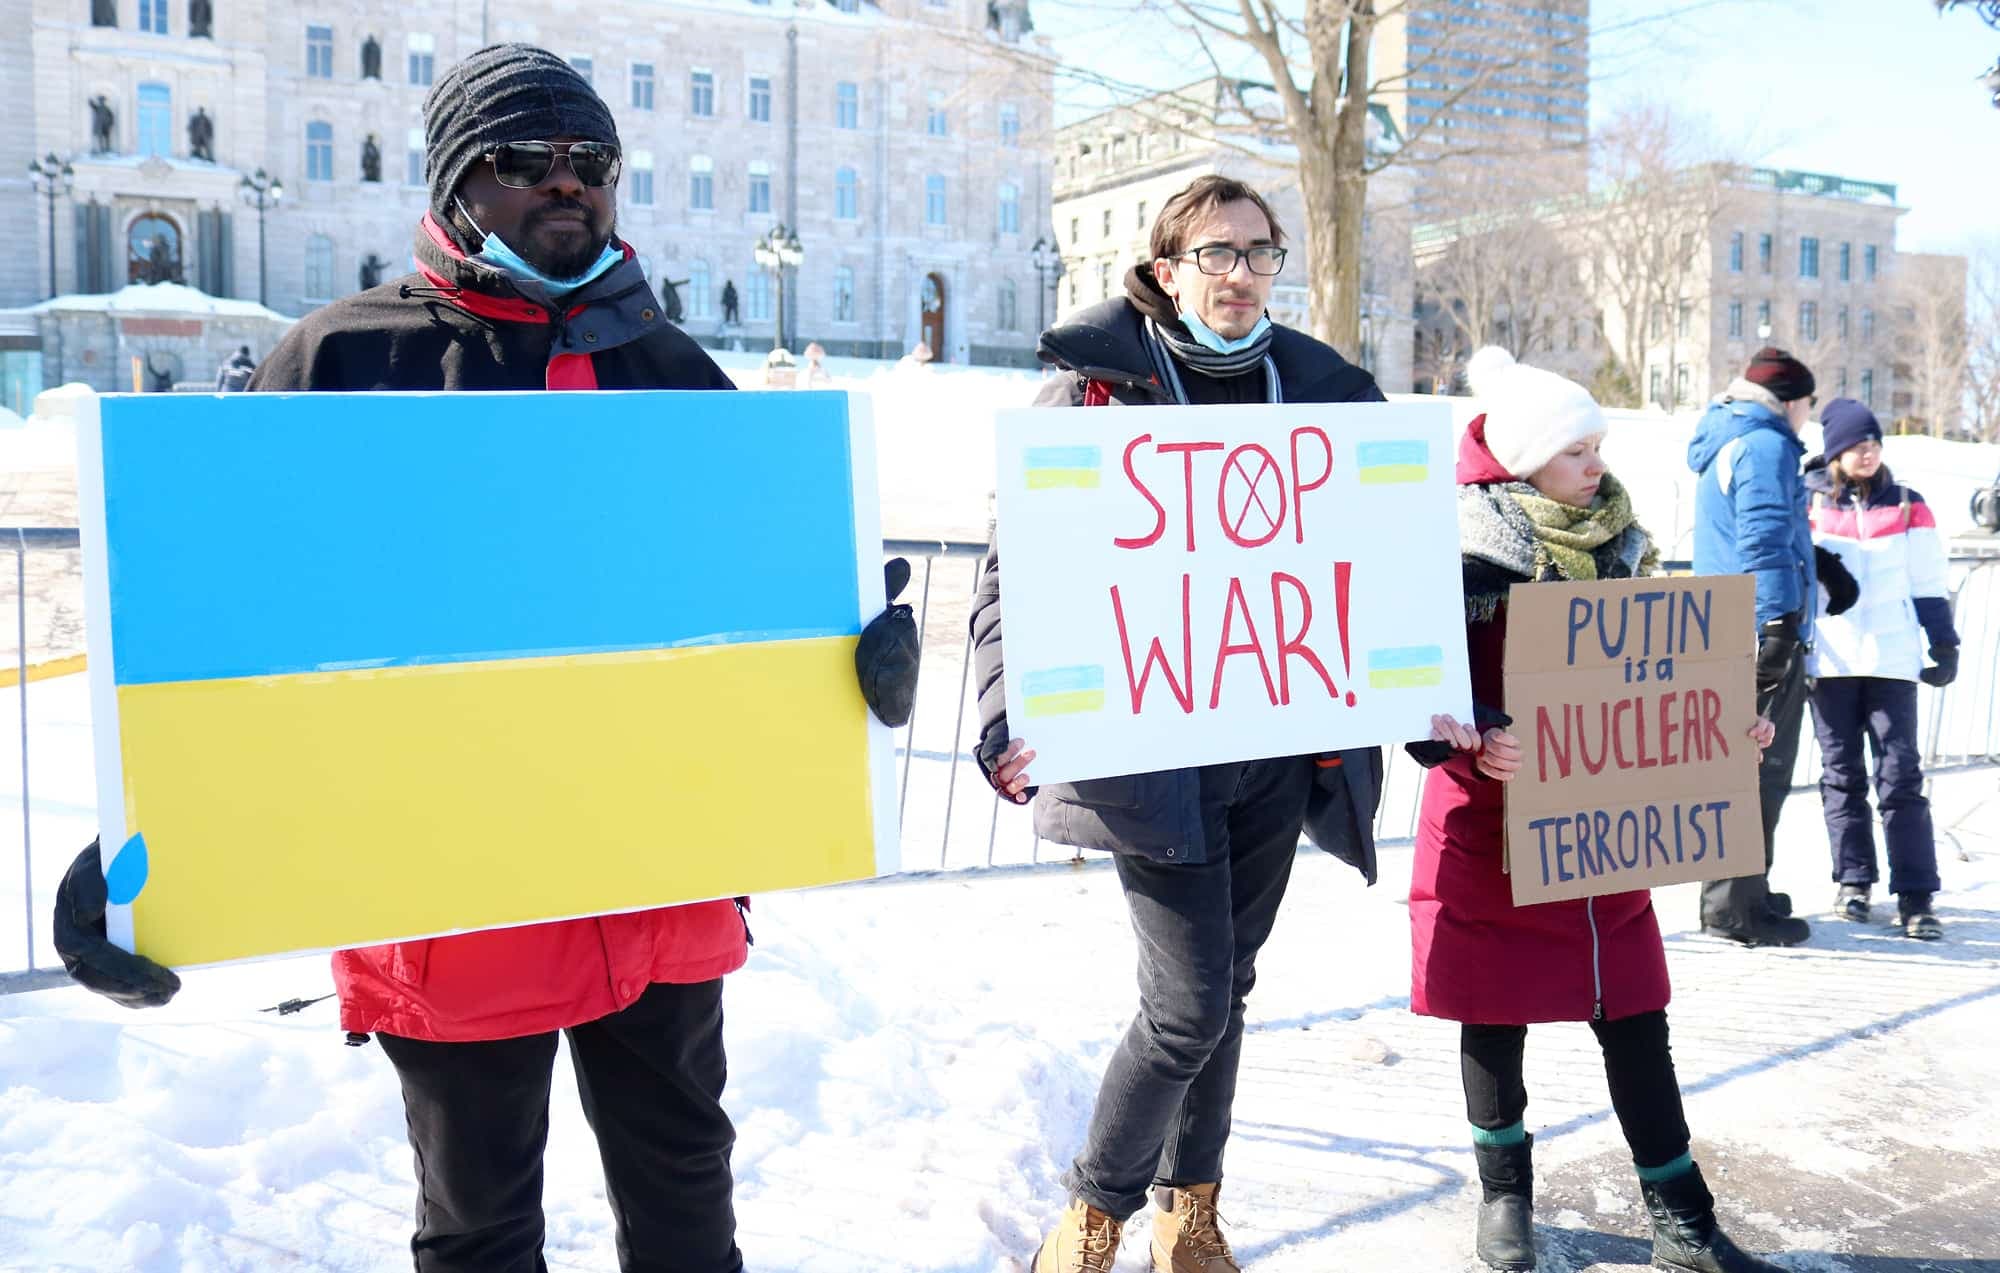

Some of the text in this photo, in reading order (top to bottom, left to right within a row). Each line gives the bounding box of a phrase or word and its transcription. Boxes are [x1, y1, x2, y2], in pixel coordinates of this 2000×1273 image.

[1113, 426, 1333, 552] STOP
[1110, 561, 1358, 714] WAR!
[1567, 589, 1712, 665] PUTIN
[1624, 656, 1673, 684] is a
[1536, 688, 1730, 783] NUCLEAR
[1528, 801, 1731, 887] TERRORIST
